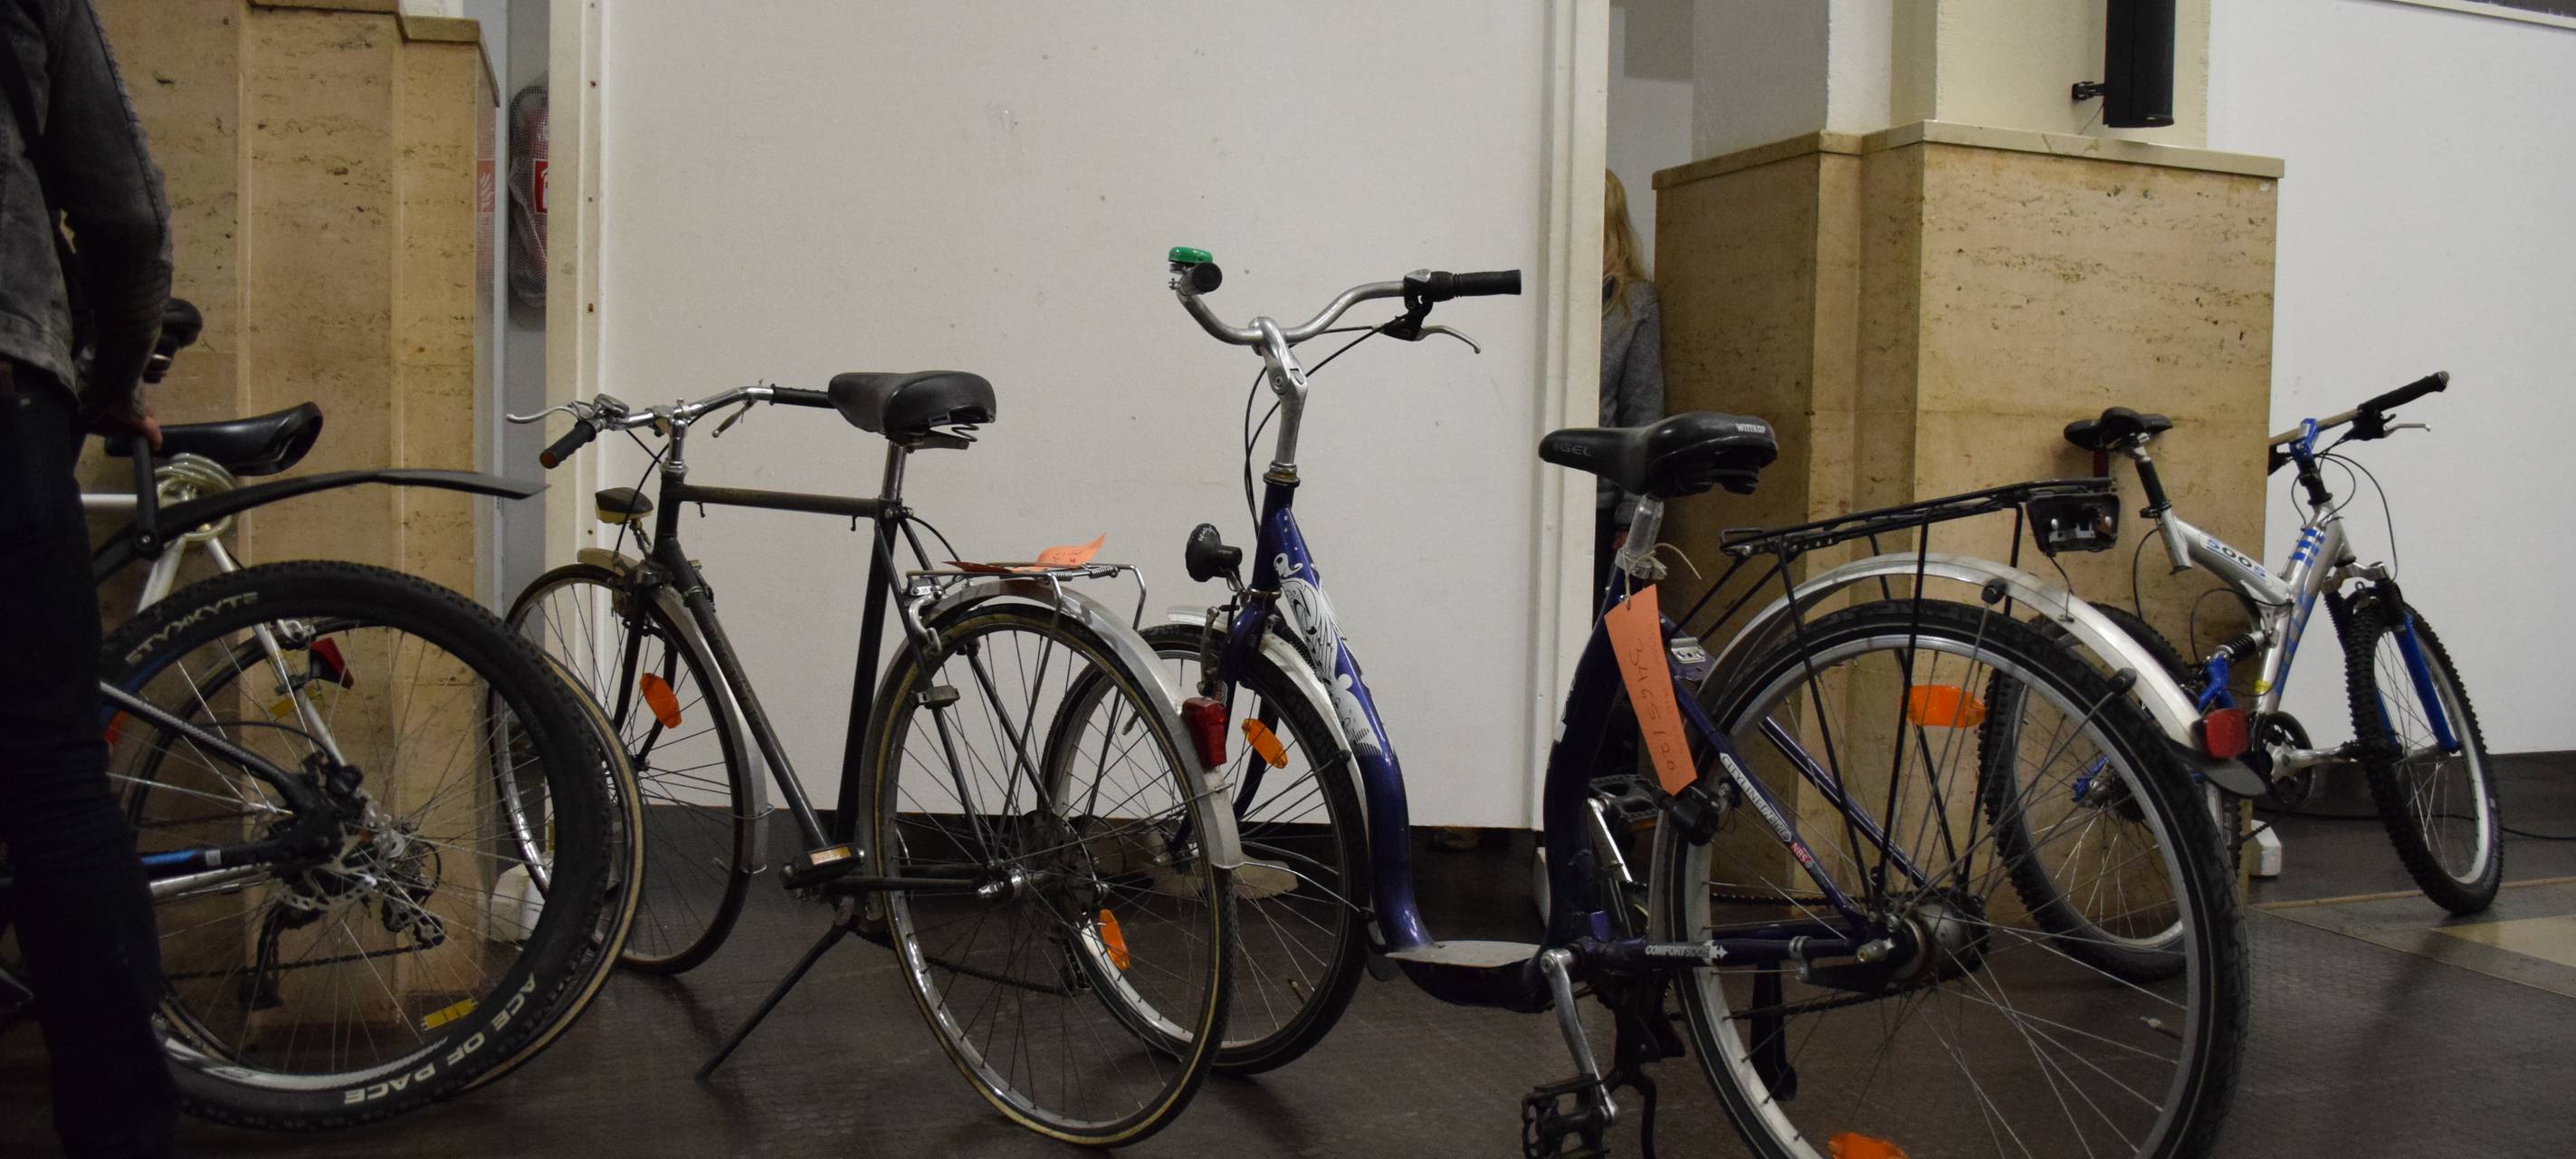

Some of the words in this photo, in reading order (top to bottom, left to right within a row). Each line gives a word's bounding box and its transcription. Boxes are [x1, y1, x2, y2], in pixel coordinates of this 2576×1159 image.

[1560, 443, 1593, 457] GEL
[491, 971, 537, 1032] ACE
[444, 1030, 485, 1067] OF
[343, 1061, 436, 1105] PACE
